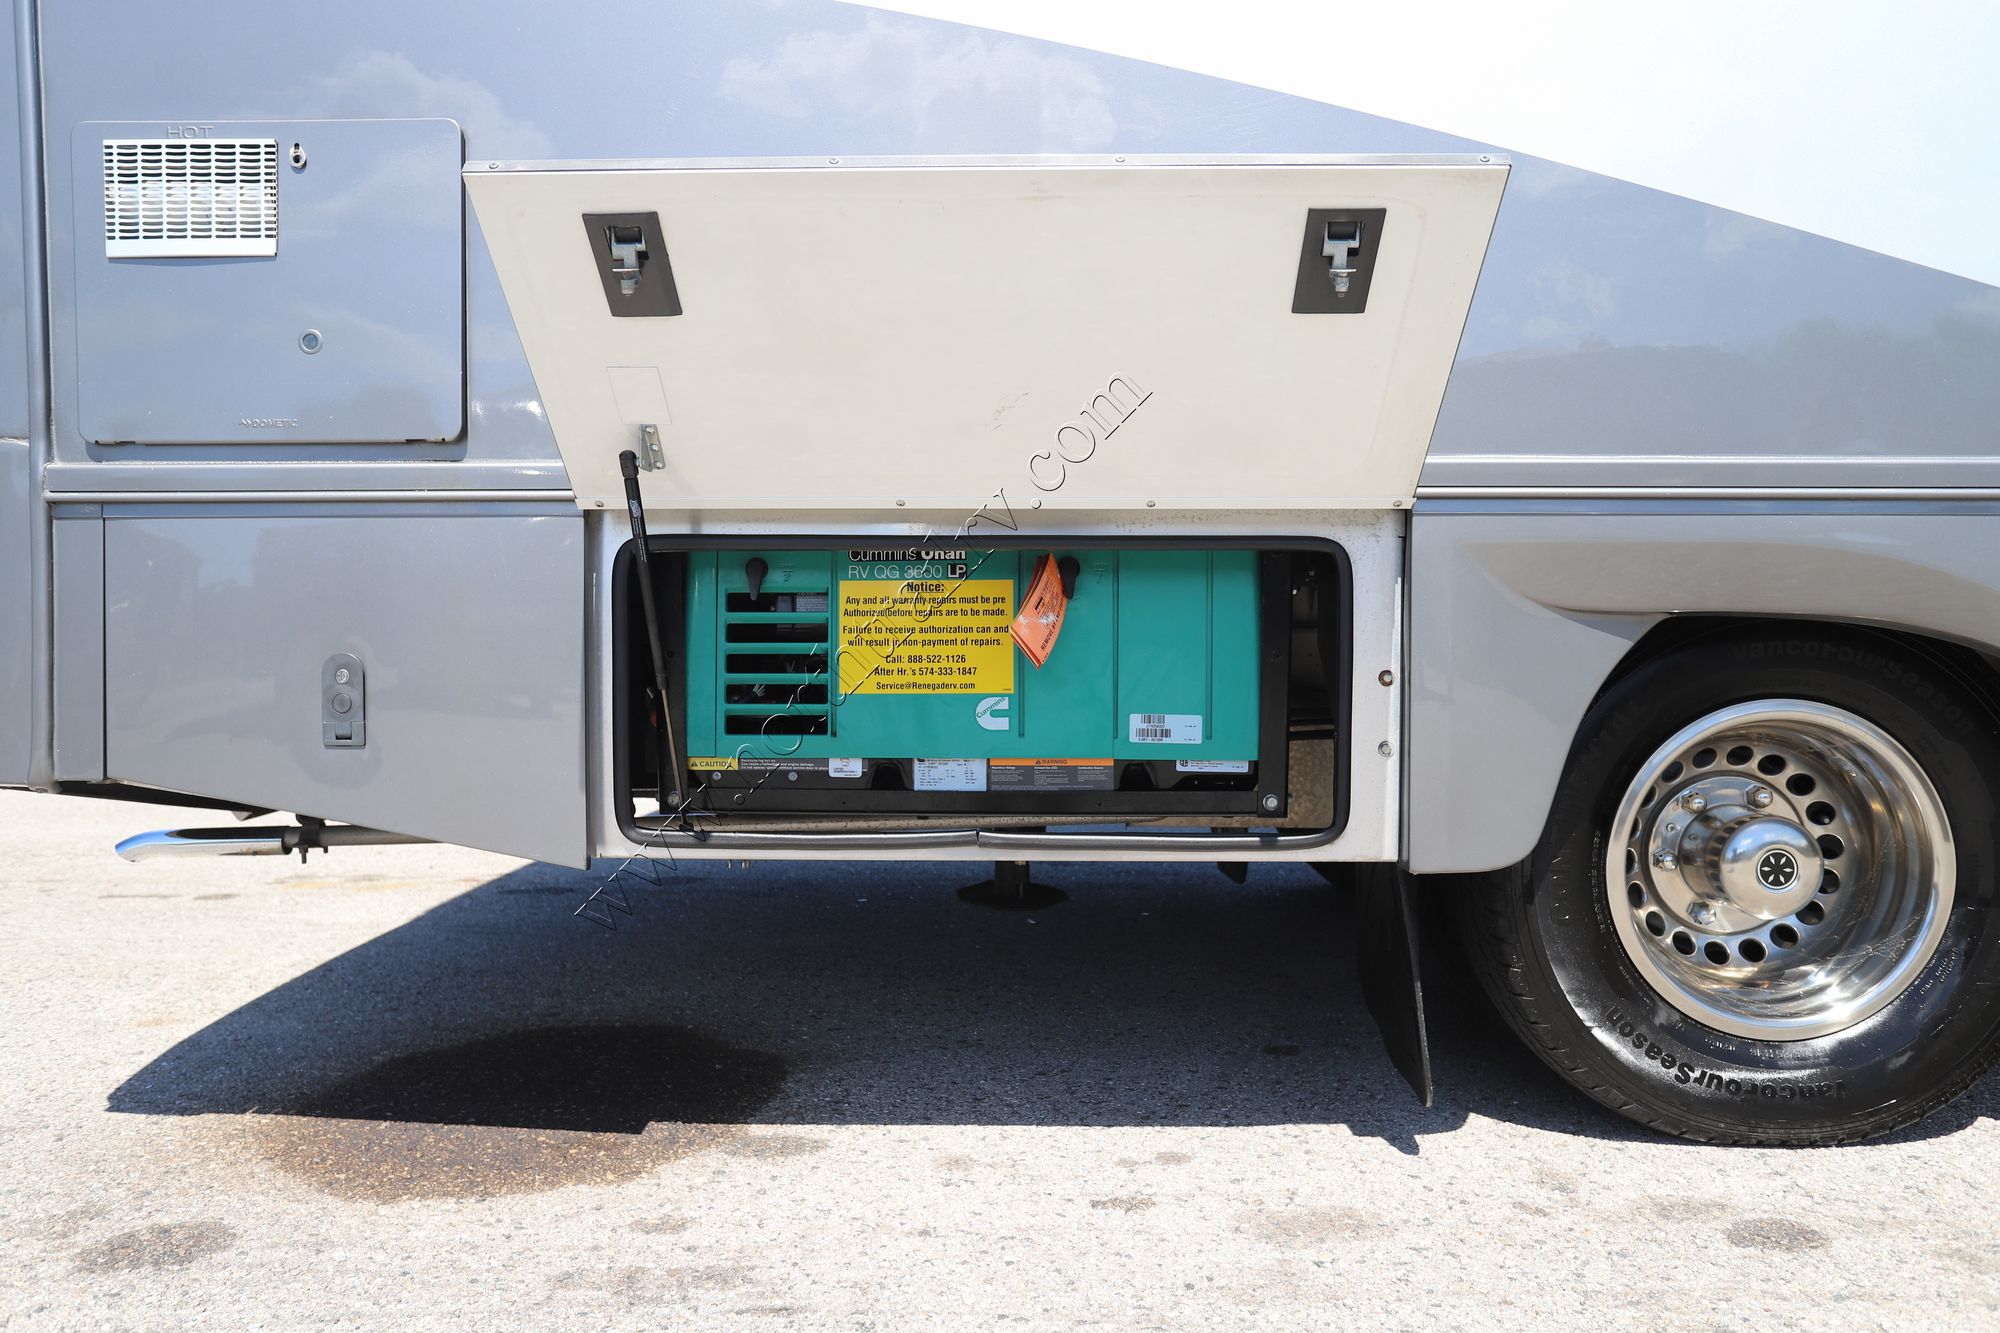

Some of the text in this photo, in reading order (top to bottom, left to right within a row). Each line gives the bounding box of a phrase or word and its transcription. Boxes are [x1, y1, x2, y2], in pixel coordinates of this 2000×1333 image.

[166, 126, 213, 139] HOT
[251, 417, 299, 429] DOMETIC
[848, 550, 917, 561] Cummins
[848, 564, 966, 579] RV QG 3600 LP
[906, 582, 945, 592] Notice:
[845, 596, 1006, 606] Any and all warranty repairs must be pre
[843, 608, 885, 617] Authorized
[888, 608, 912, 617] before
[915, 609, 943, 619] repairs
[960, 609, 968, 617] to
[970, 608, 979, 617] be
[981, 608, 1008, 617] made.
[842, 625, 872, 634] Failure
[875, 626, 883, 634] to
[886, 625, 916, 634] receive
[918, 625, 974, 634] authorization
[993, 625, 1009, 634] and
[848, 638, 863, 647] will
[866, 638, 890, 647] result
[903, 638, 958, 649] non-payment
[960, 638, 968, 647] of
[971, 638, 1003, 648] repairs.
[885, 655, 966, 664] Call: 888-522-1126
[874, 668, 893, 677] After
[918, 668, 977, 677] 574-333-1847
[876, 682, 976, 691] Service@Renegaderv.com
[976, 697, 1006, 718] Cummins
